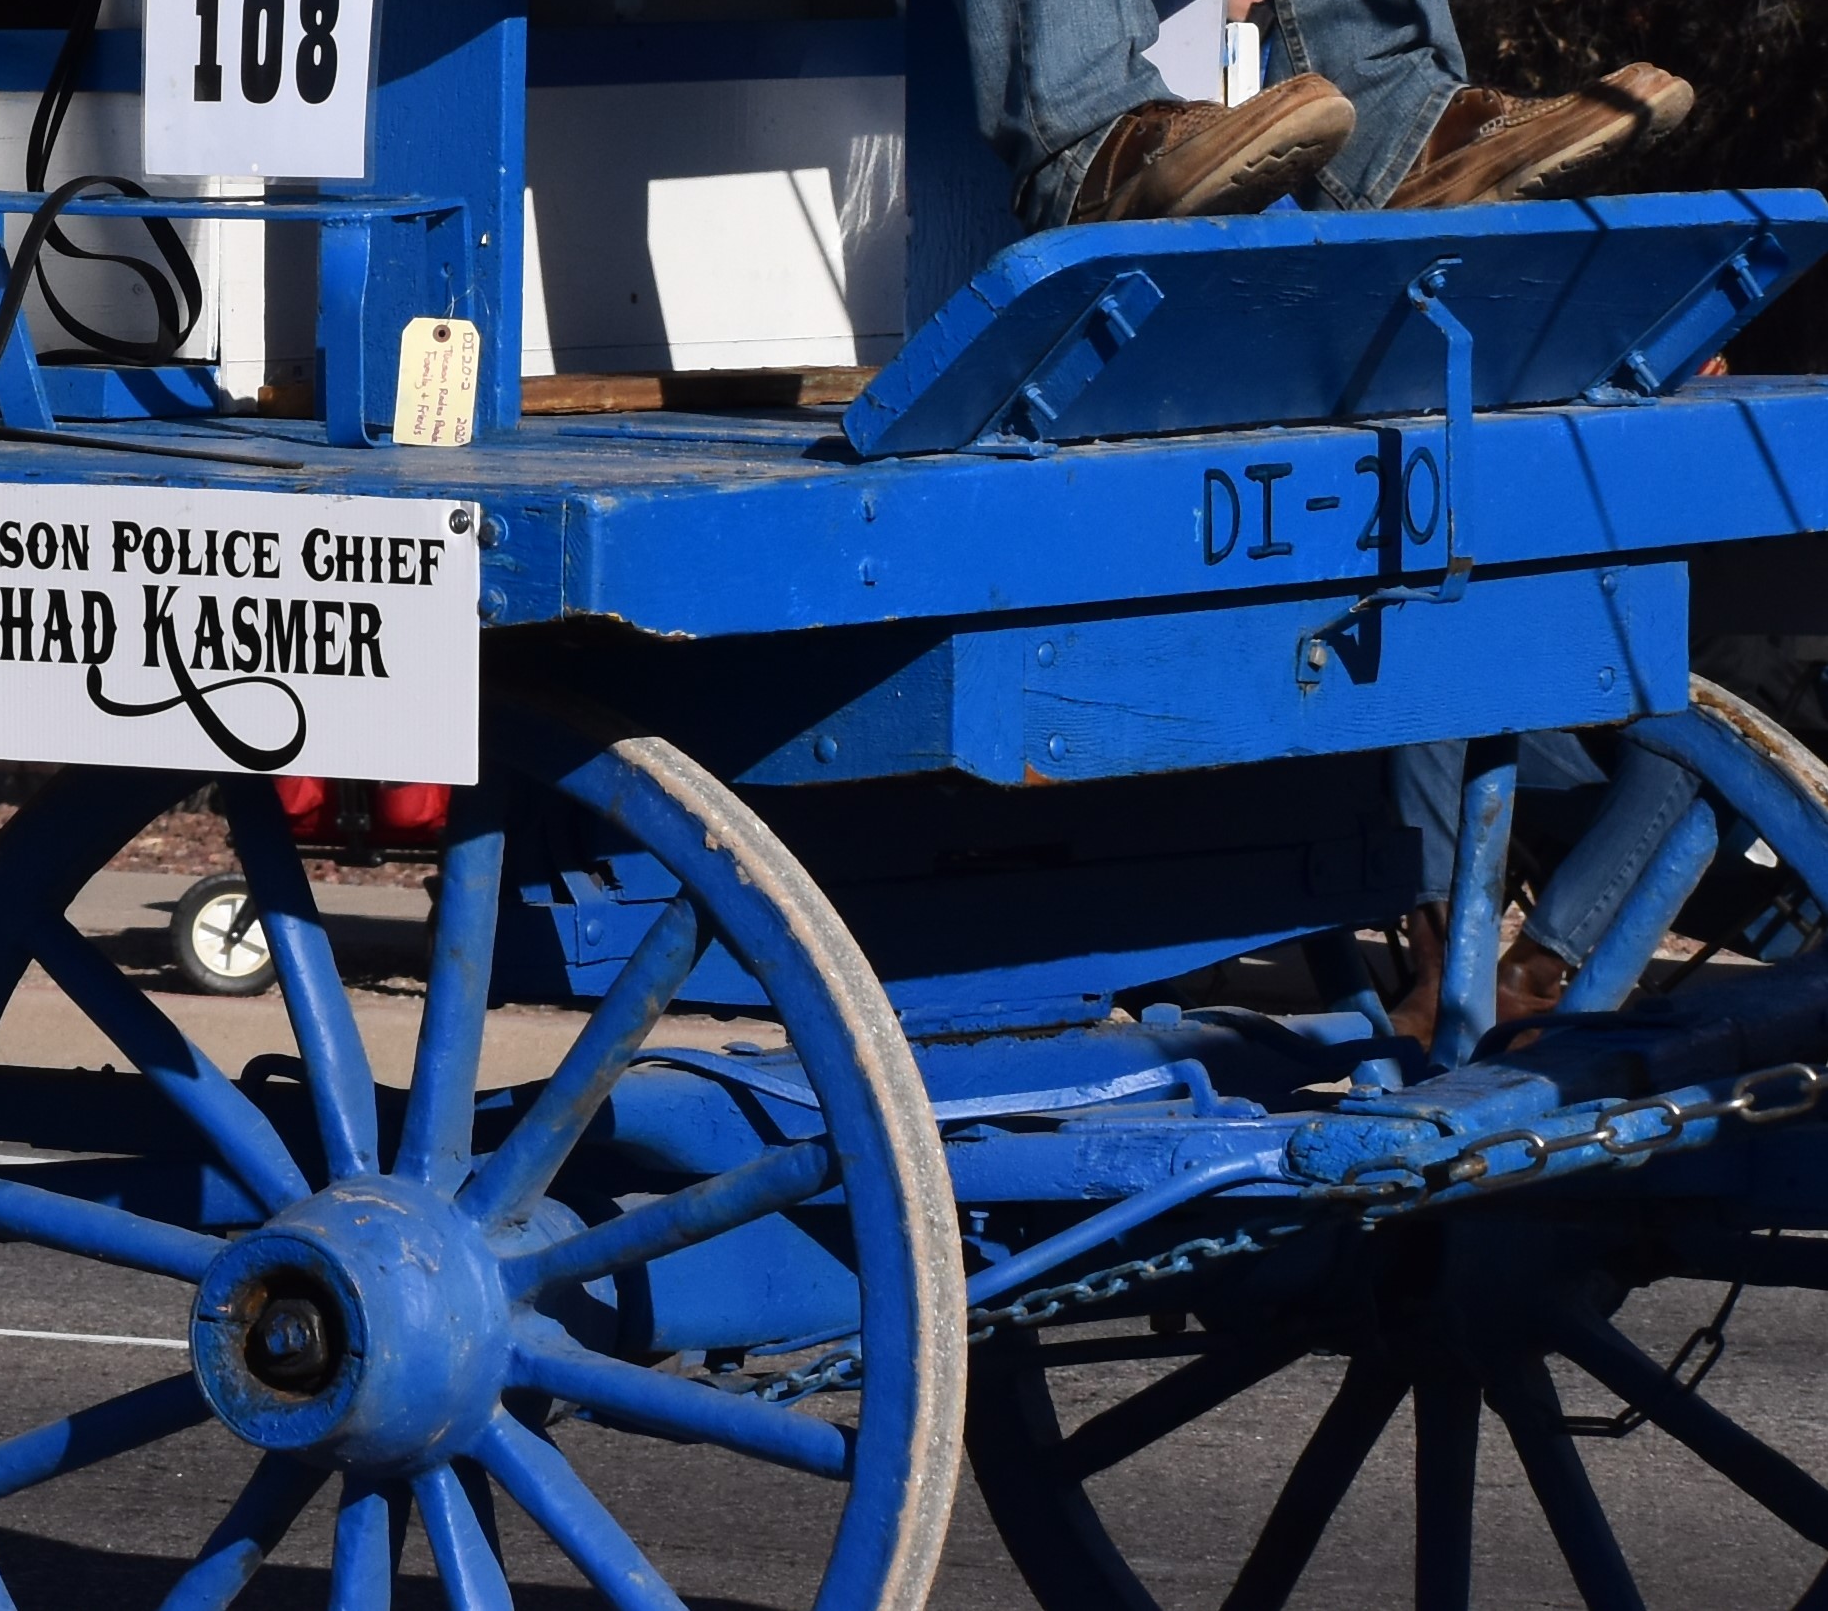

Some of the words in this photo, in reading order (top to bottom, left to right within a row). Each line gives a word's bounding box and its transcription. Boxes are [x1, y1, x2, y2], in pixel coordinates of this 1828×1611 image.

[414, 351, 437, 390] Family
[440, 345, 453, 383] Tucson
[436, 388, 448, 416] Rodeo
[1203, 446, 1441, 566] DI-20
[112, 520, 281, 579] POLICE
[300, 527, 446, 586] CHIEF
